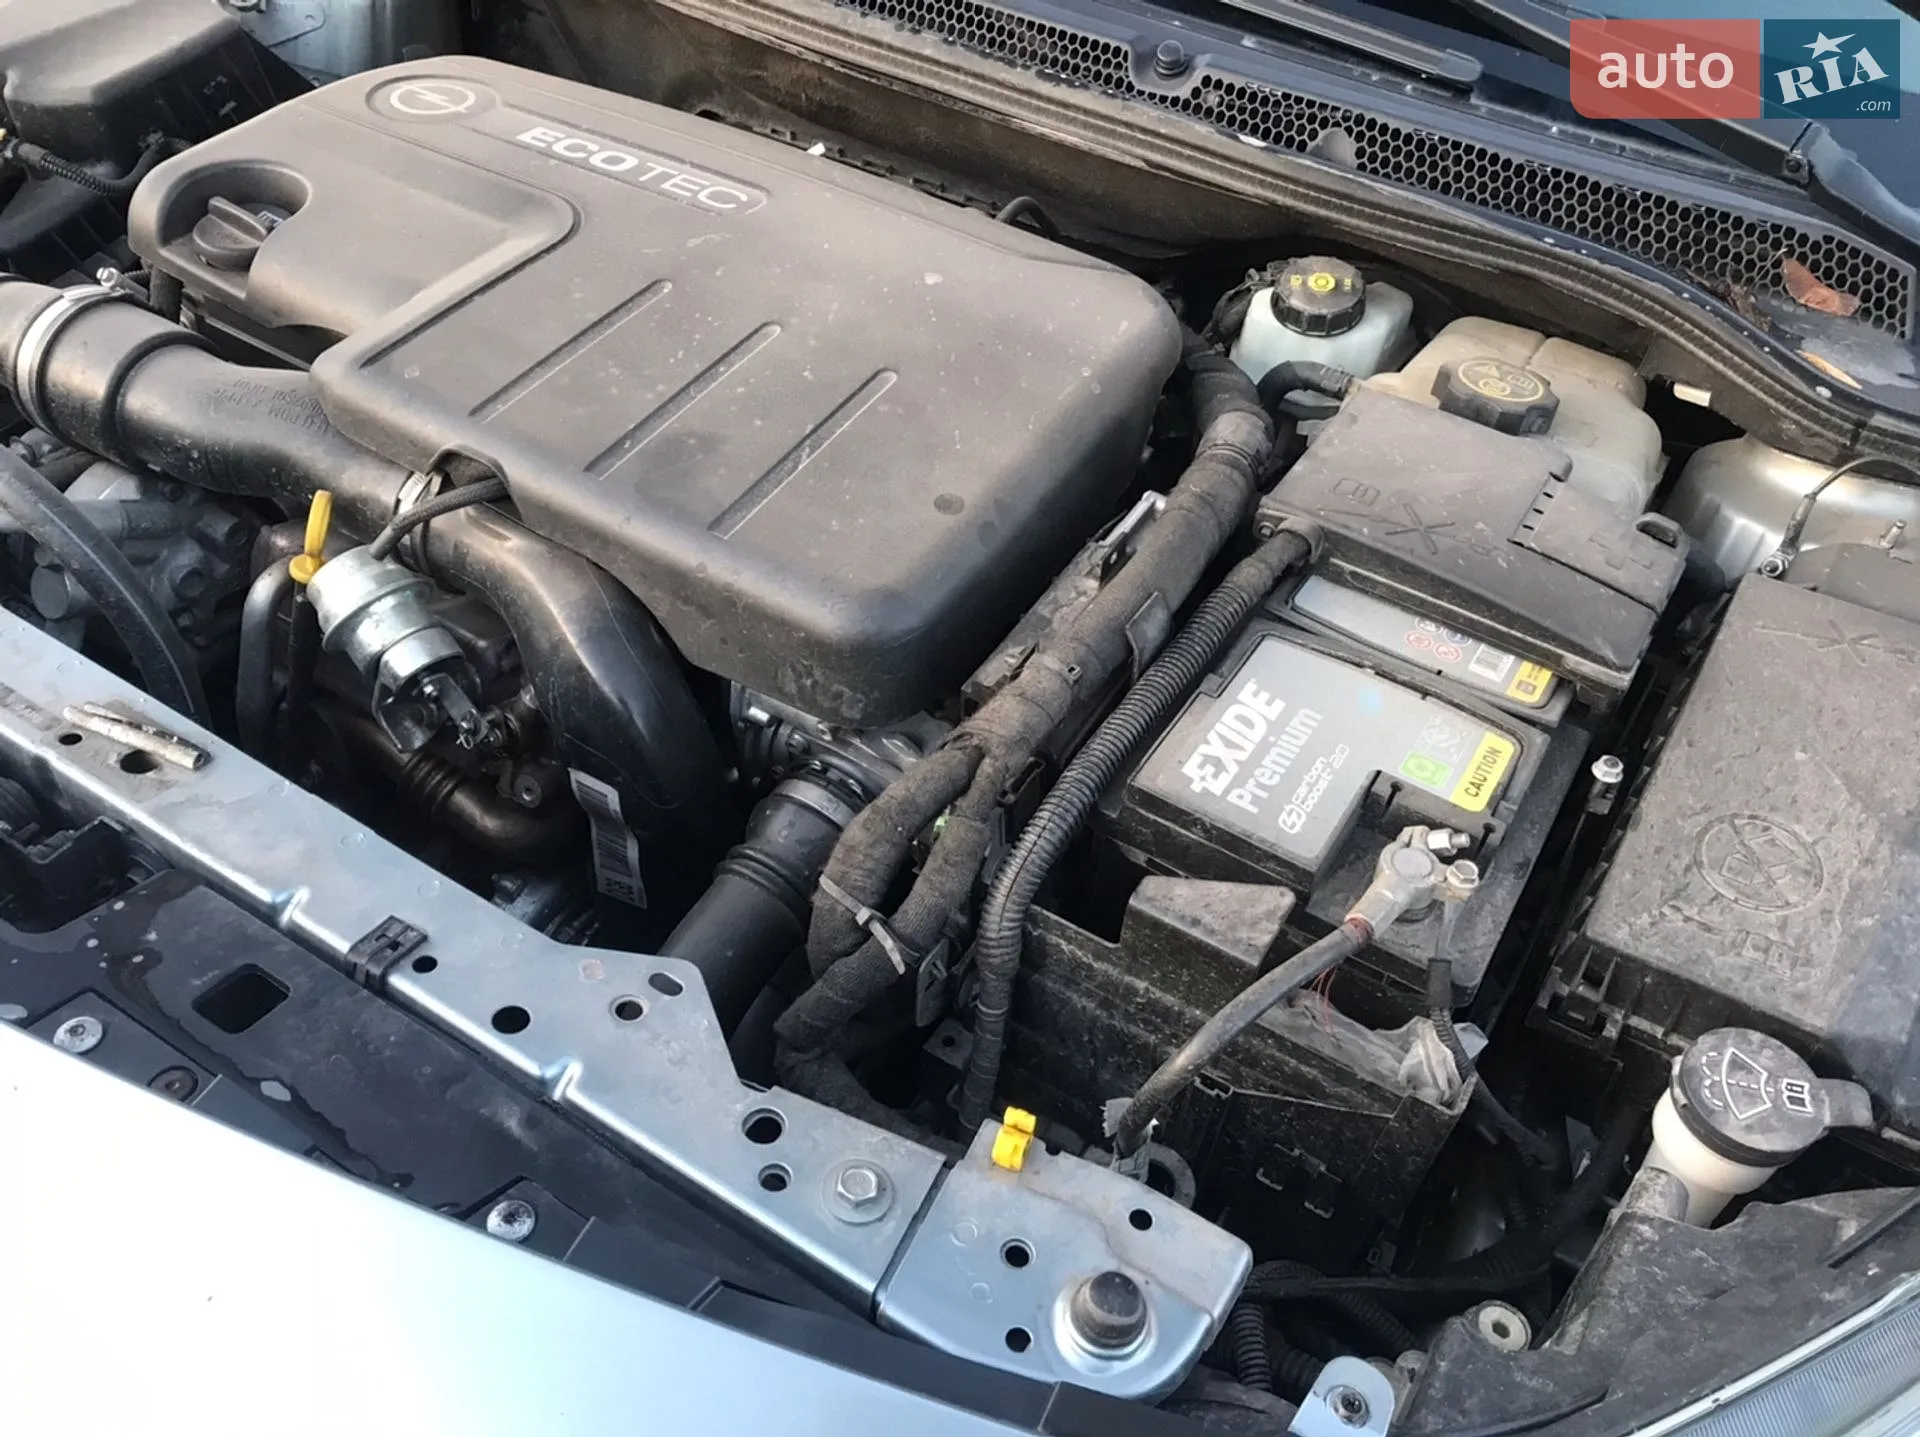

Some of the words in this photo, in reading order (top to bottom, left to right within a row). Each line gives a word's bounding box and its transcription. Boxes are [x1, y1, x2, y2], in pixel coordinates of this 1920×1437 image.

[516, 126, 748, 208] ECOTEC
[1181, 680, 1286, 796] EXIDE
[1226, 708, 1324, 814] Premium
[1464, 745, 1502, 798] CAUTION
[1292, 757, 1327, 805] carbon
